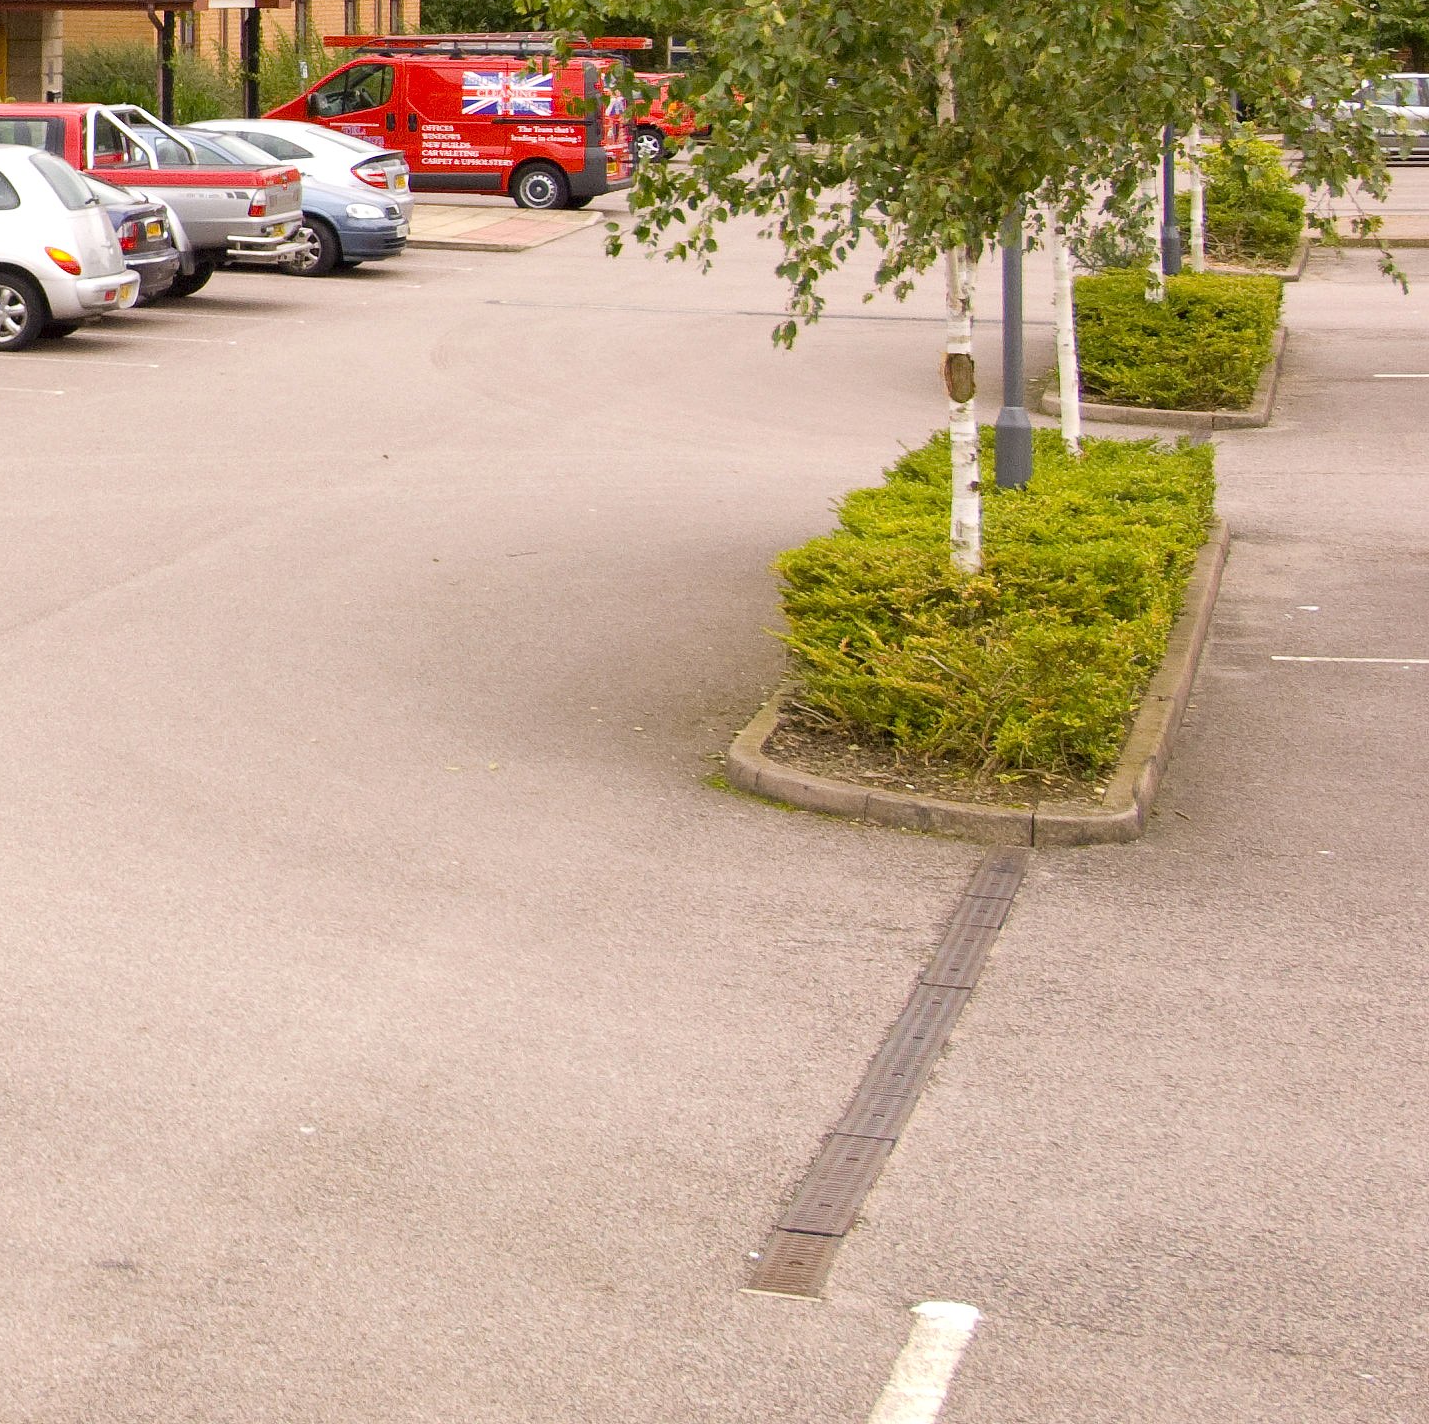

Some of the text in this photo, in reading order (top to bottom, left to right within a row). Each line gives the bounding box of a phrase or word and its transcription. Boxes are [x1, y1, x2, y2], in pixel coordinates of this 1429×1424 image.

[476, 88, 537, 97] CLEANING
[421, 124, 455, 132] OFFICES
[517, 125, 575, 133] The Team that's
[511, 134, 537, 143] leading
[422, 141, 472, 149] NEW BUILDS
